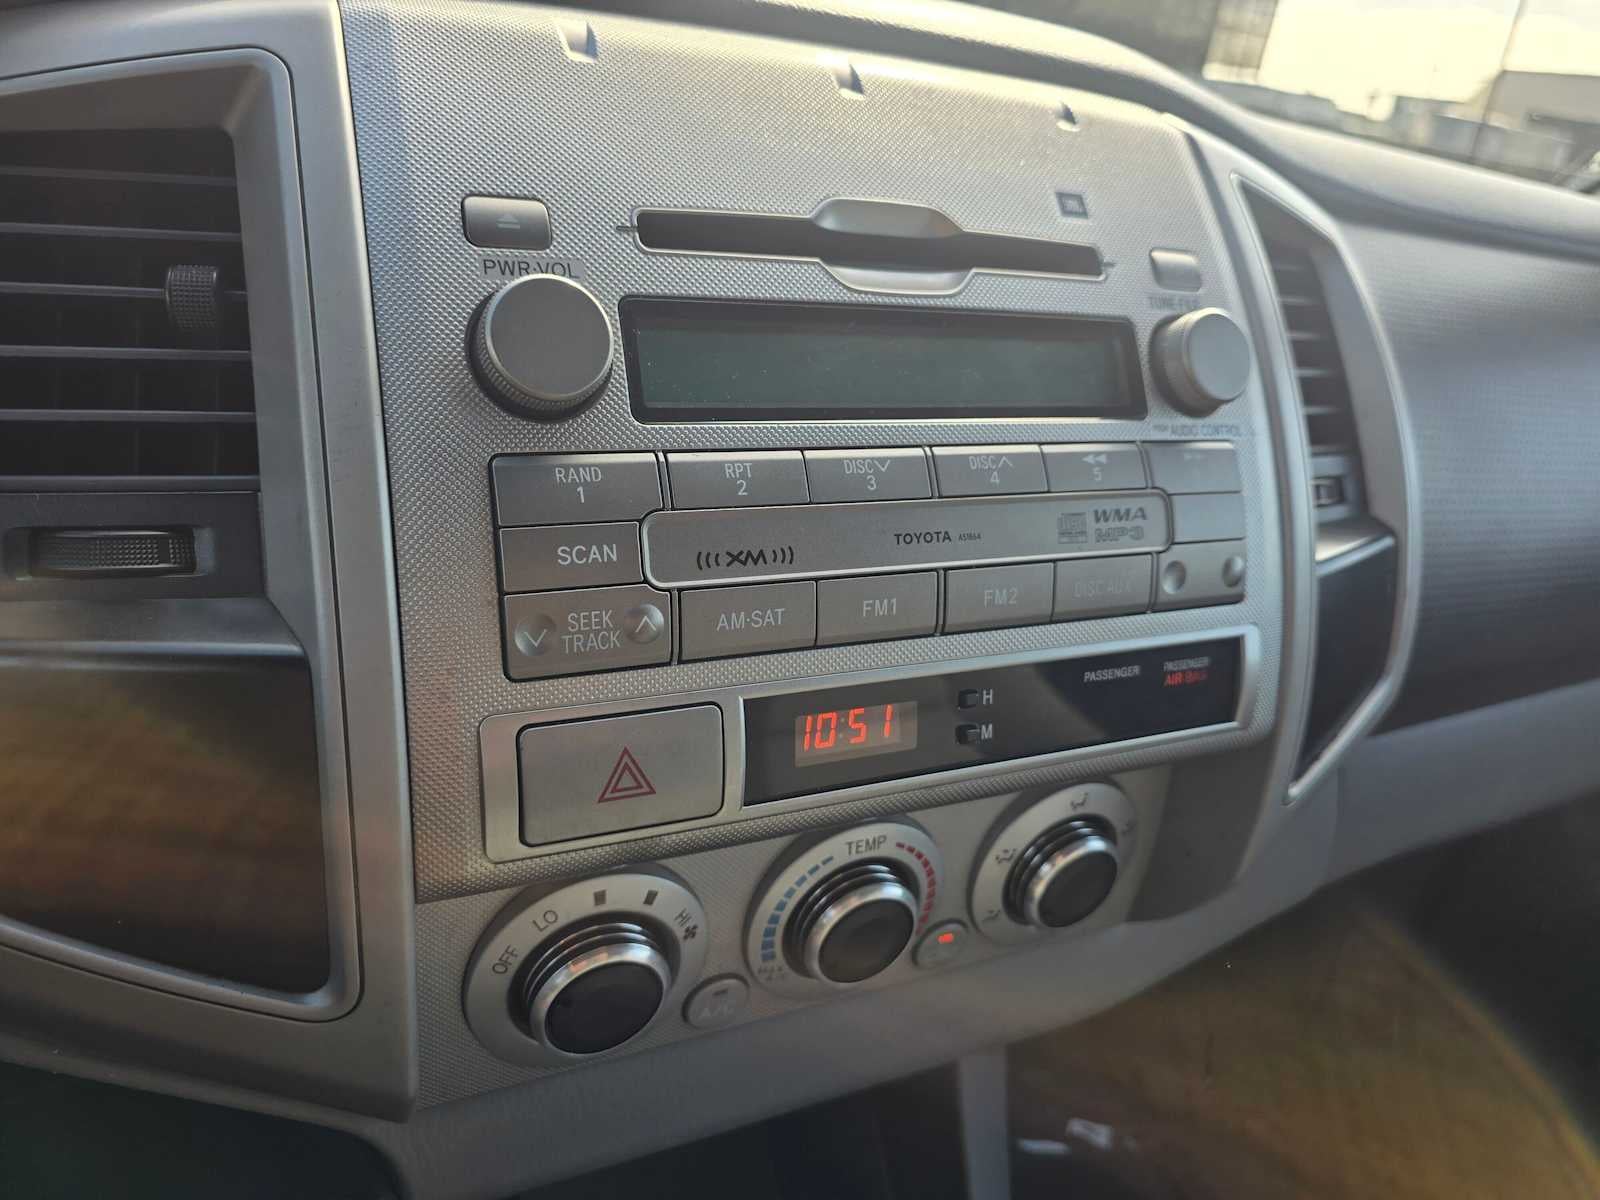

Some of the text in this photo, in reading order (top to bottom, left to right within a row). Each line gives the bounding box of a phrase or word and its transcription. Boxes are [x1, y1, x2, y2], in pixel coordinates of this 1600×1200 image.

[724, 463, 753, 480] RPT
[843, 458, 874, 474] DISC
[968, 455, 998, 471] DISC
[555, 465, 602, 484] RAND
[866, 475, 878, 491] 3
[990, 471, 1001, 485] 4
[577, 486, 586, 504] 1
[736, 480, 749, 496] 2
[1093, 507, 1148, 524] WMA
[894, 530, 953, 546] TOYOTA
[556, 543, 618, 566] SCAN
[861, 597, 898, 617] FM1
[983, 589, 1019, 608] FM2
[567, 610, 614, 633] SEEK
[561, 630, 621, 655] TRACK
[1084, 665, 1141, 683] PASSENGER
[982, 688, 993, 705] H
[803, 704, 894, 752] 10:51
[980, 723, 993, 740] M
[845, 834, 887, 857] TEMP
[532, 909, 559, 933] LO
[677, 909, 691, 927] HI
[491, 943, 519, 976] OFF
